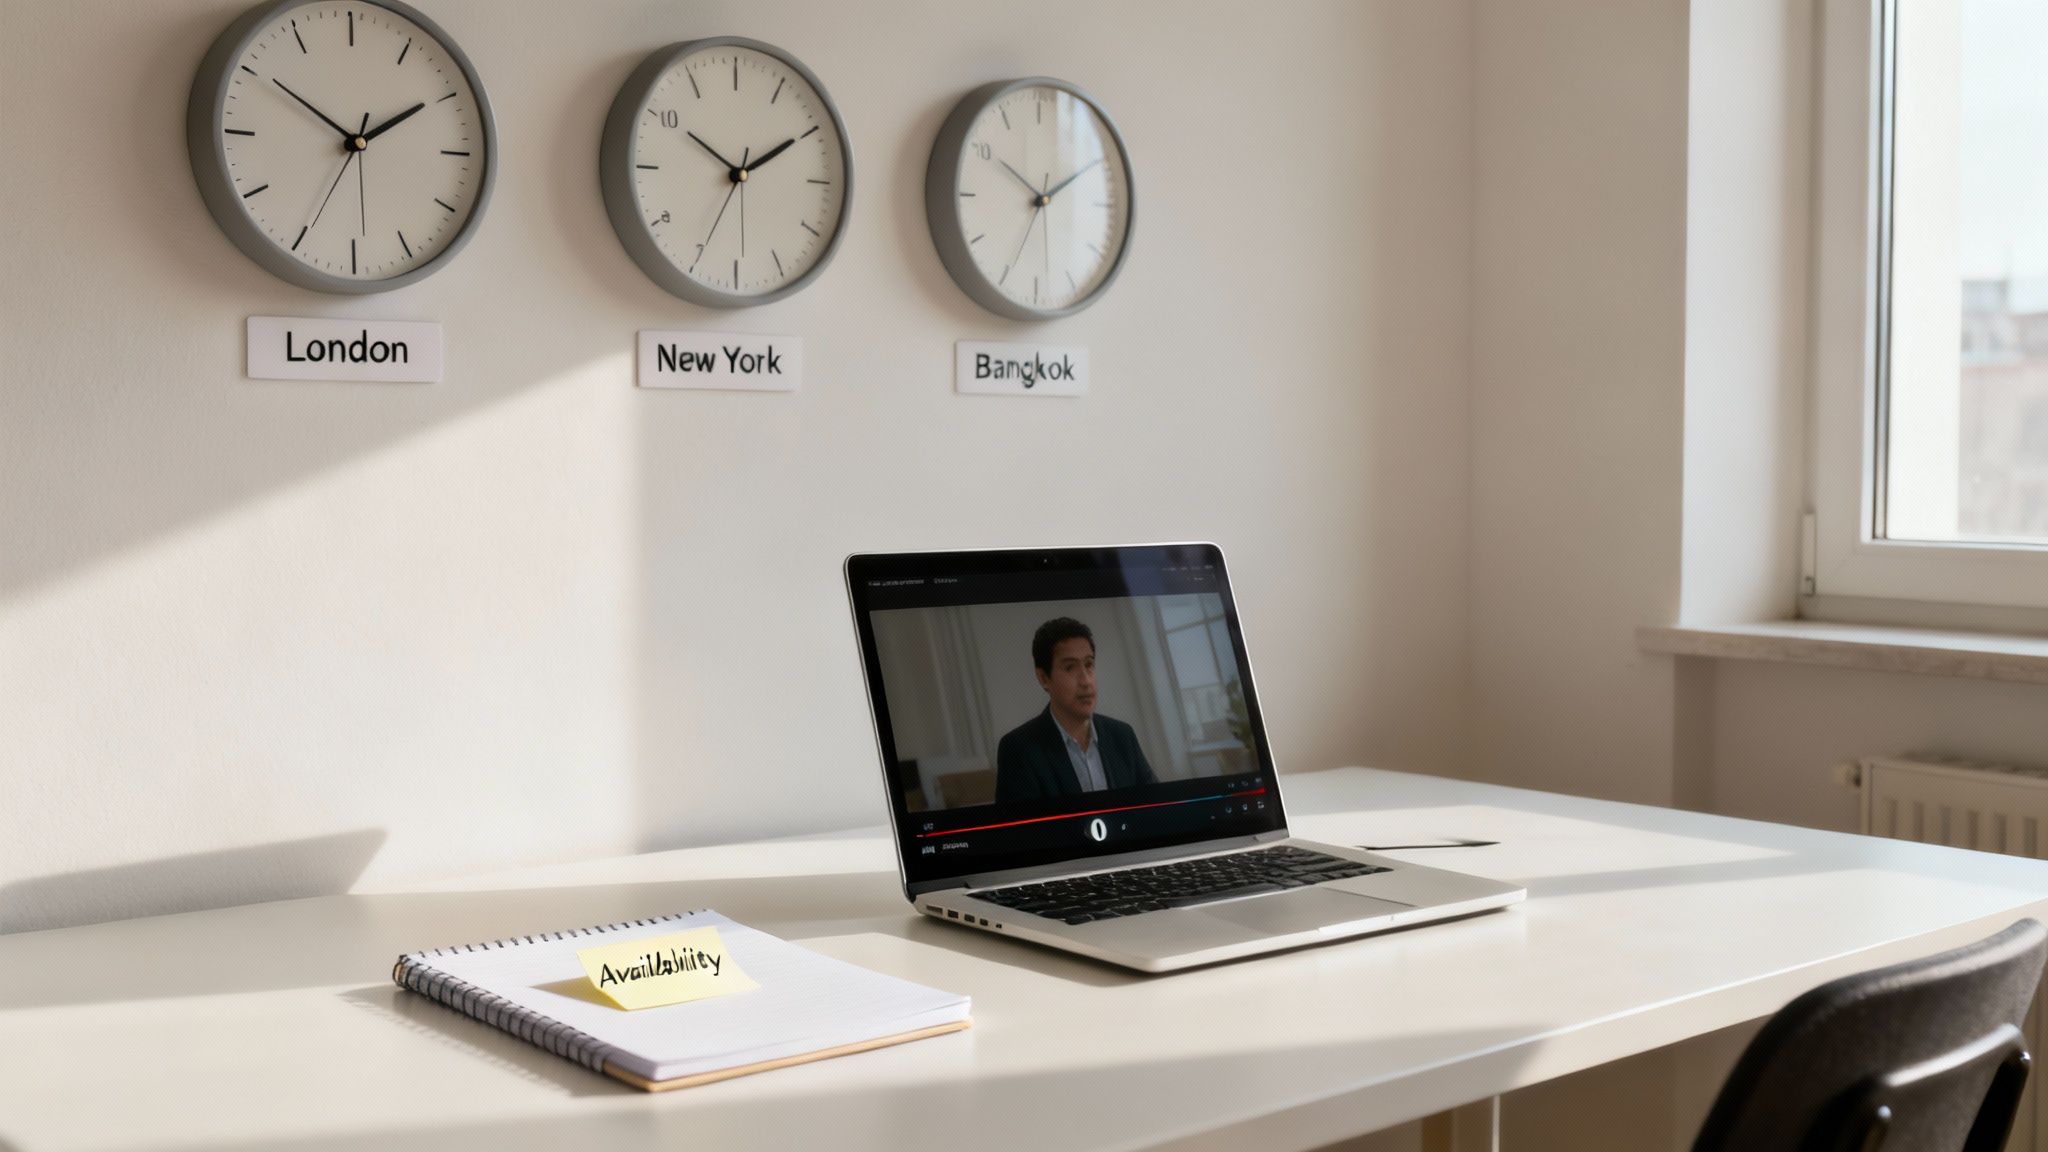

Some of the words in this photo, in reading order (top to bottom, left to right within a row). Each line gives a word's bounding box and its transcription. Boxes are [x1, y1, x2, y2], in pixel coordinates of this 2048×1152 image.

[286, 329, 408, 363] London
[657, 343, 717, 373] New
[722, 344, 783, 375] York
